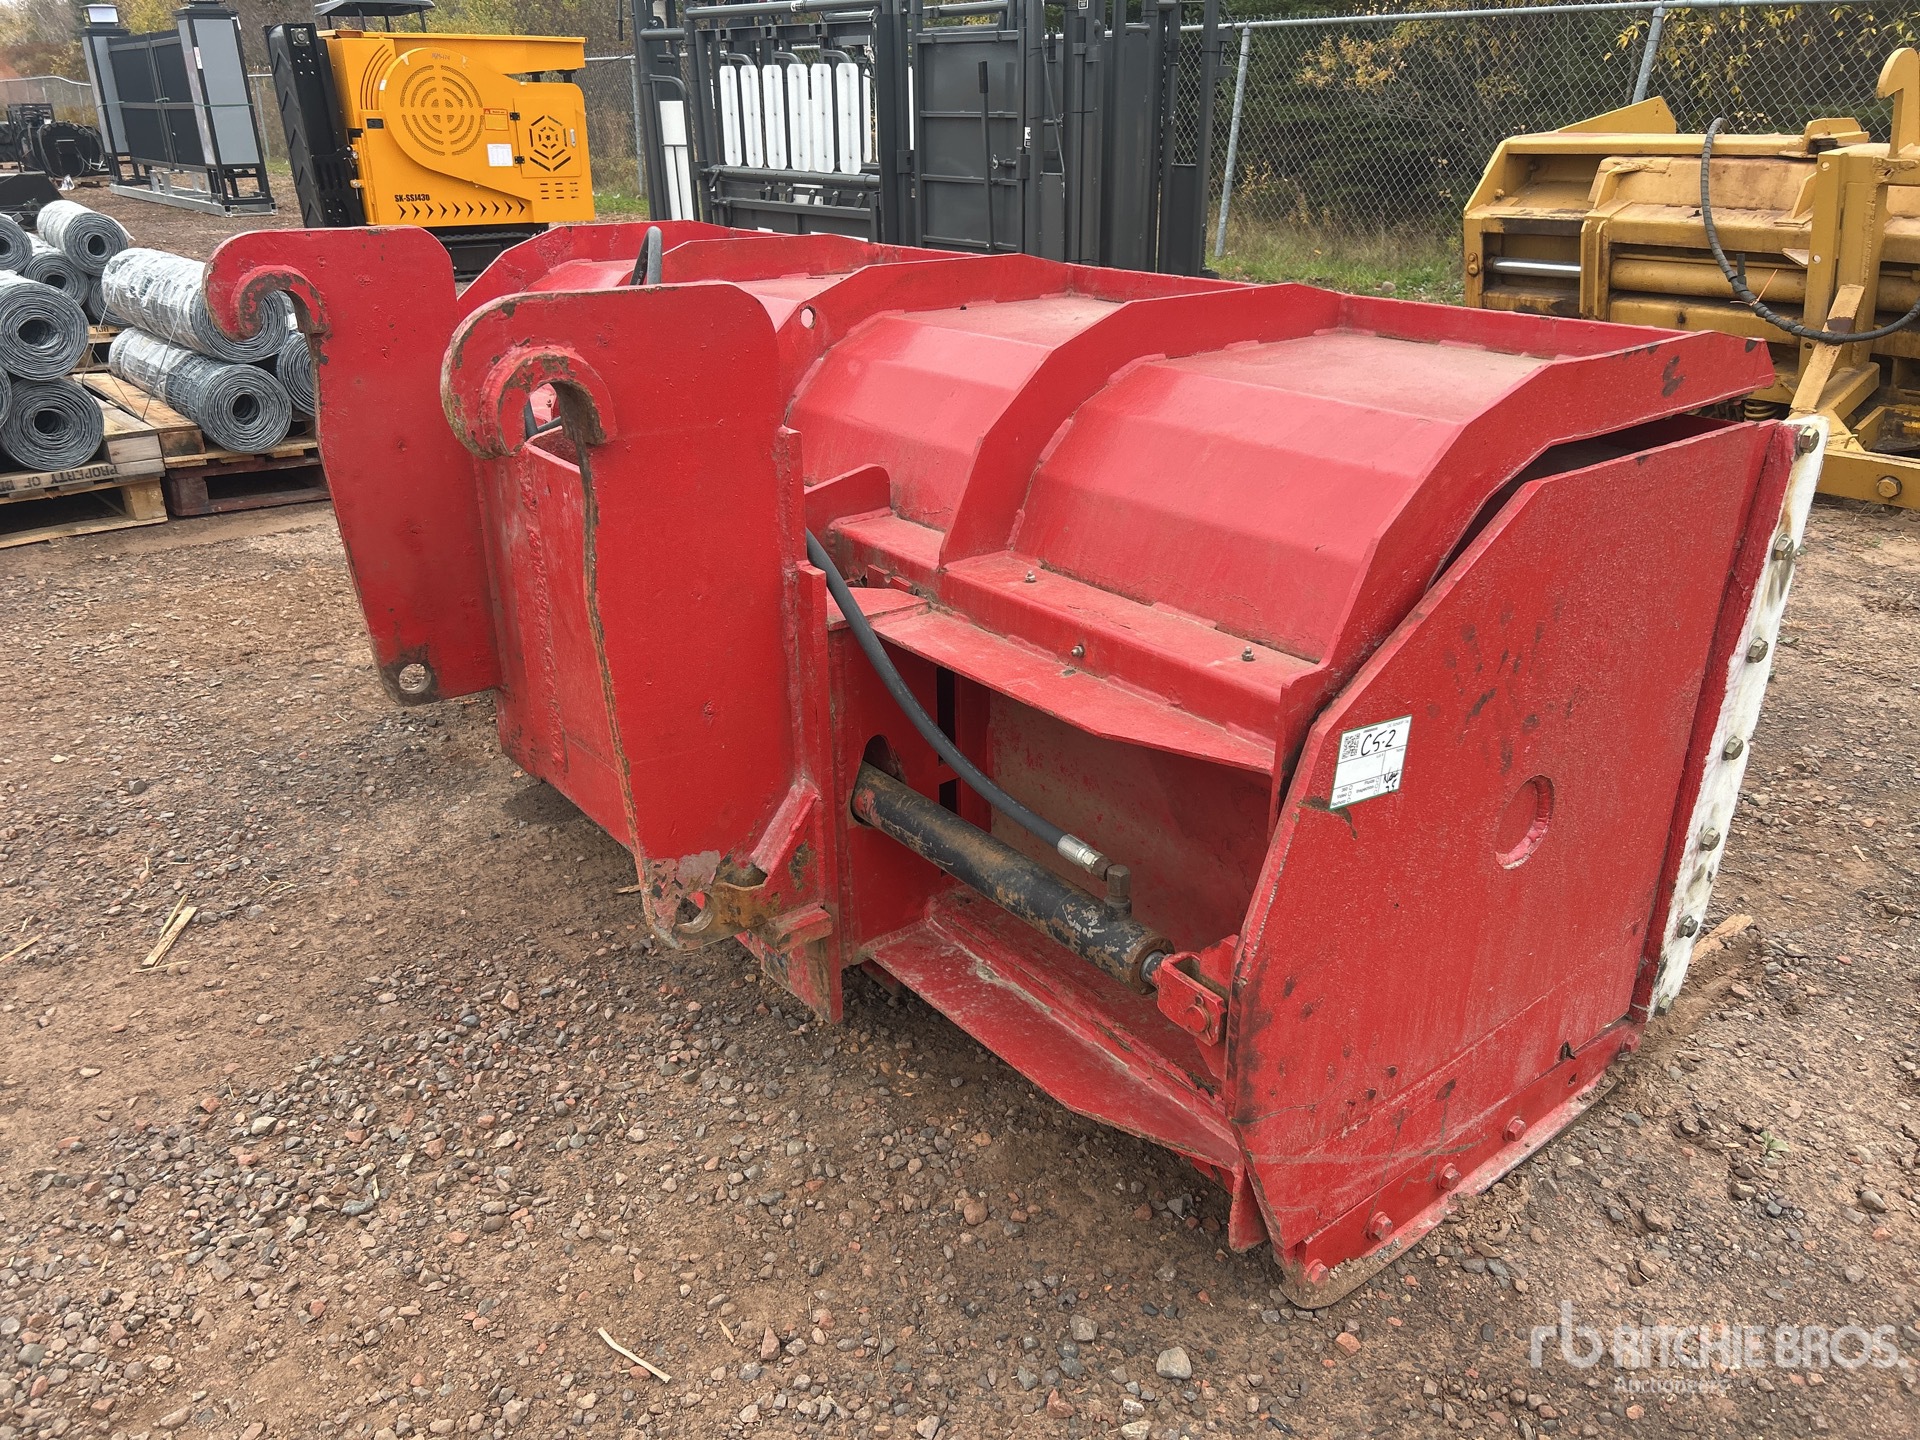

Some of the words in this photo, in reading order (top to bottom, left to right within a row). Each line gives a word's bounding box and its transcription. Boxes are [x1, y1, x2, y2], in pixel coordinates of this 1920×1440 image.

[394, 193, 431, 203] SK-SSJ430
[51, 465, 118, 484] PROPERTY
[24, 476, 42, 488] OF
